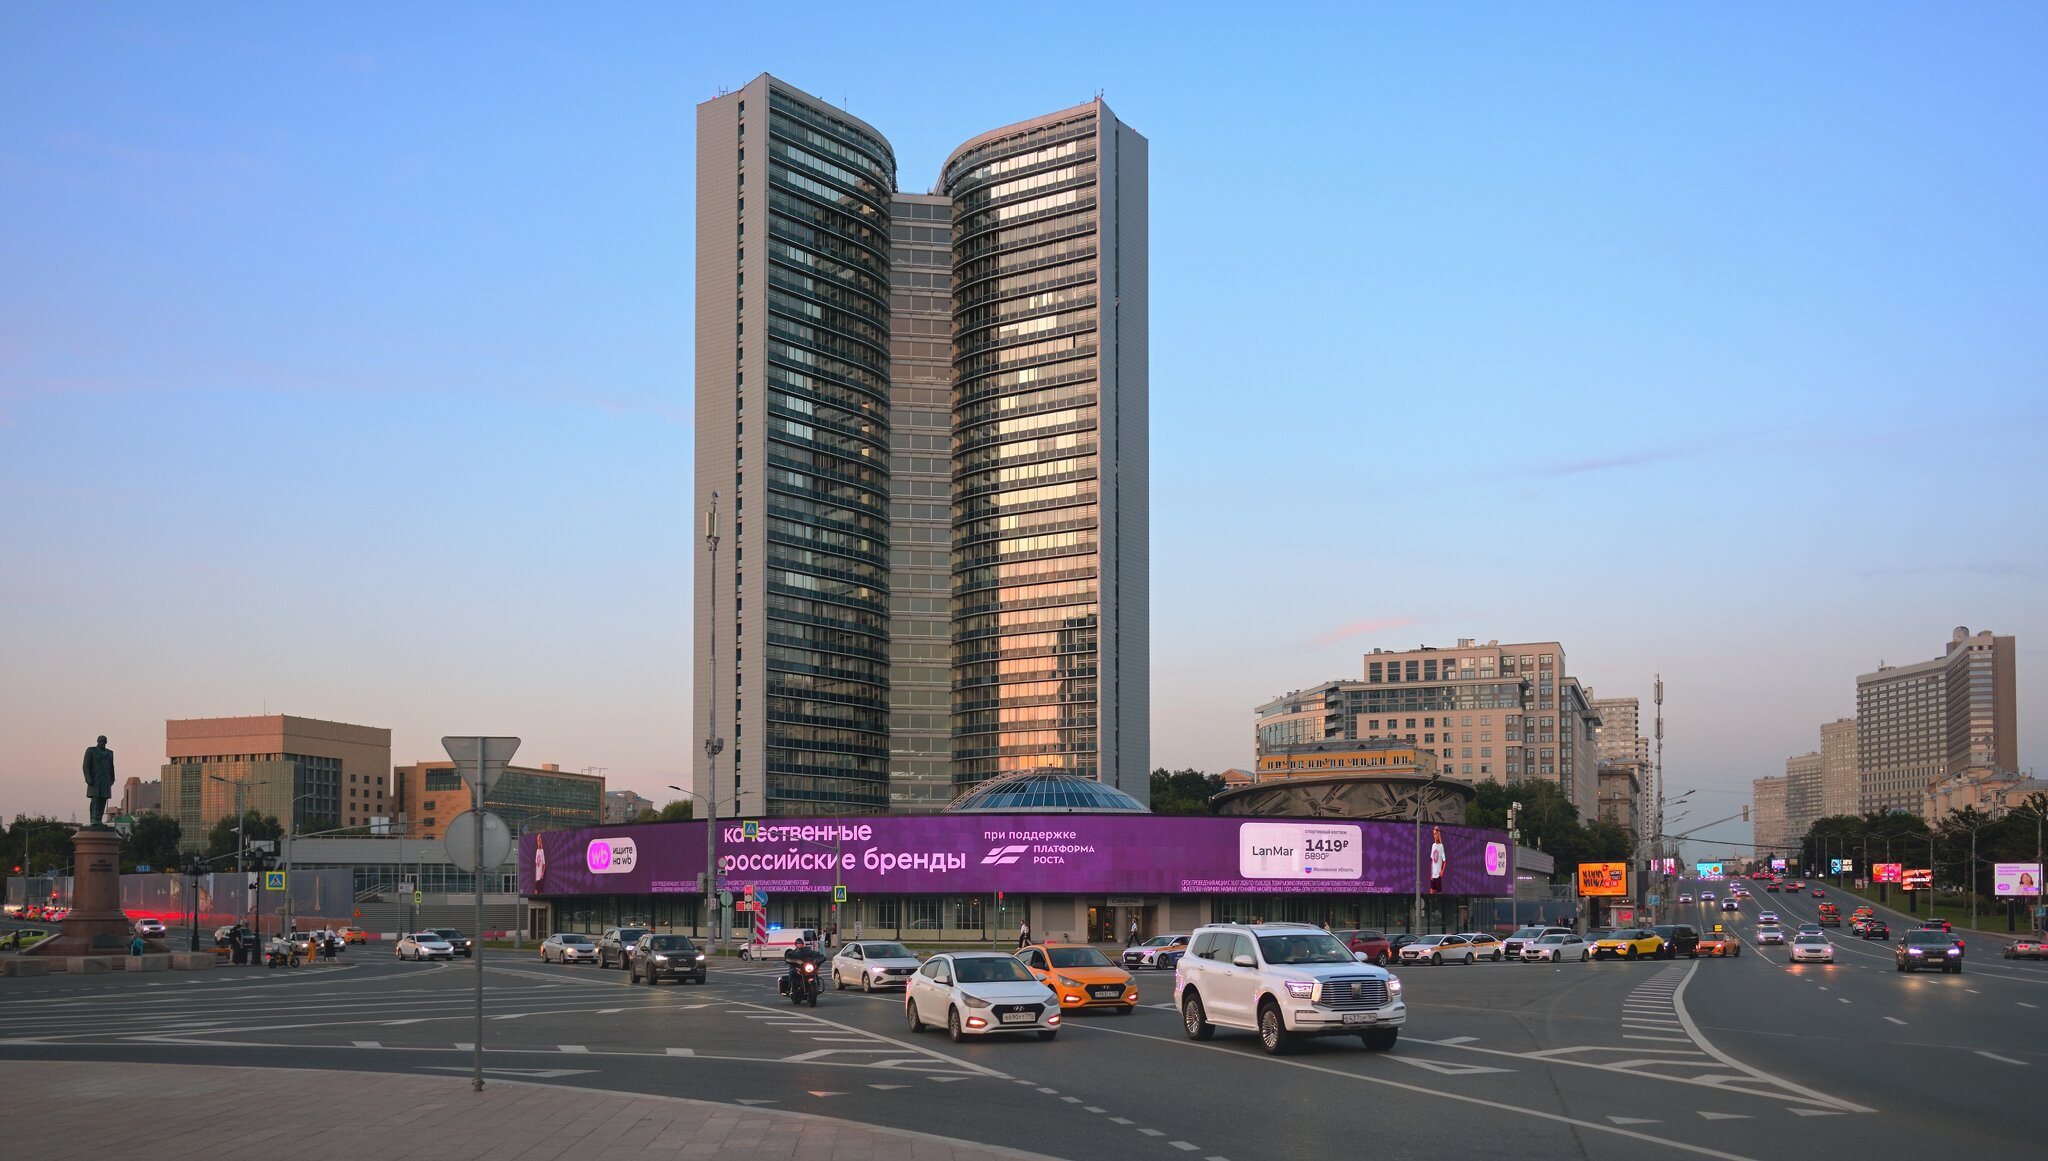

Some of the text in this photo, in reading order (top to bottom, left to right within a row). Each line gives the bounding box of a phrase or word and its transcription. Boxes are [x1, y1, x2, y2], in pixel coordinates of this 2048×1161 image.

[724, 824, 872, 843] каественные
[984, 831, 1077, 841] при поддержке
[612, 846, 633, 855] ищите
[1033, 845, 1095, 853] ПЛАТФОРМА
[1252, 845, 1294, 856] LanMar
[591, 845, 609, 865] wb
[622, 855, 632, 865] wb
[1033, 856, 1065, 864] РОСТА
[724, 846, 966, 875] российские бренды
